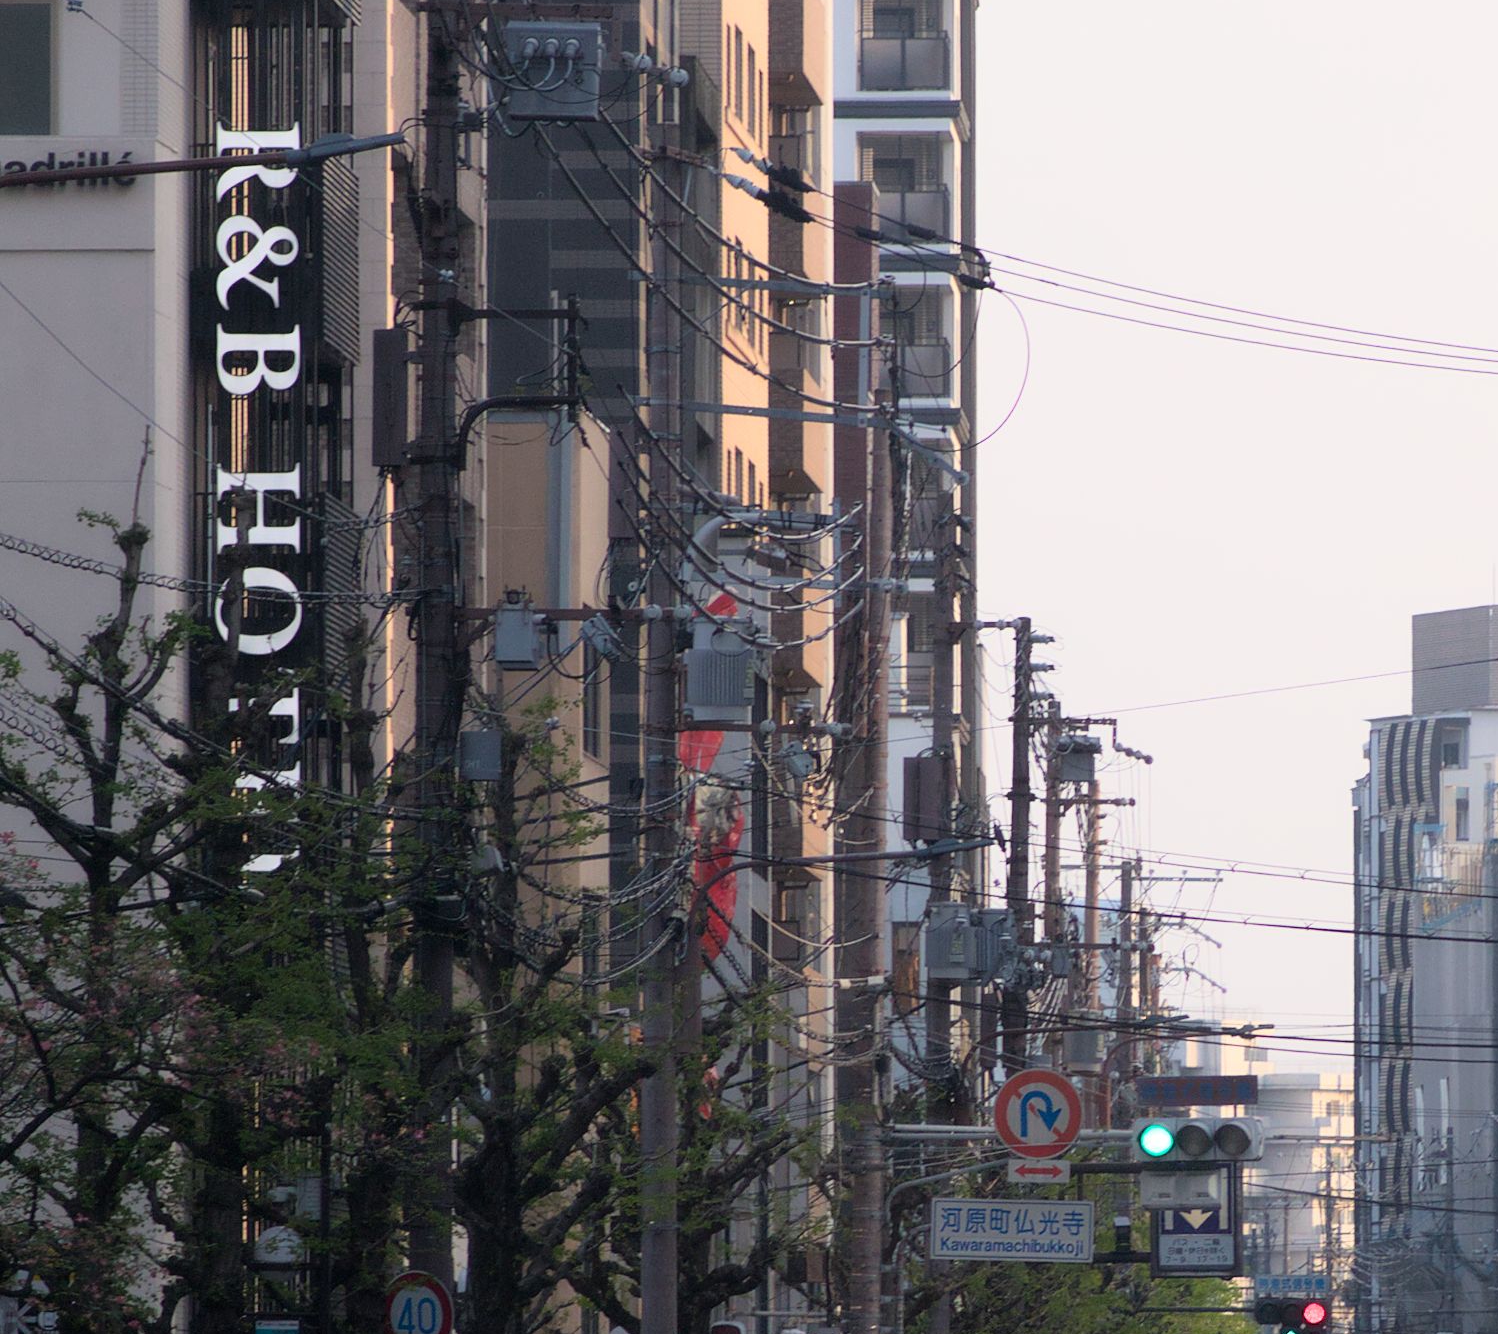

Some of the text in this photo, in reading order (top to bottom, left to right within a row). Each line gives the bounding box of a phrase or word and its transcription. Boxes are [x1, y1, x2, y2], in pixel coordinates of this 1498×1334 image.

[216, 121, 300, 396] R&B
[940, 1207, 1085, 1237] 河原町仏光寺
[940, 1236, 1084, 1257] Kawaramachibukkoji
[398, 1297, 436, 1334] 40
